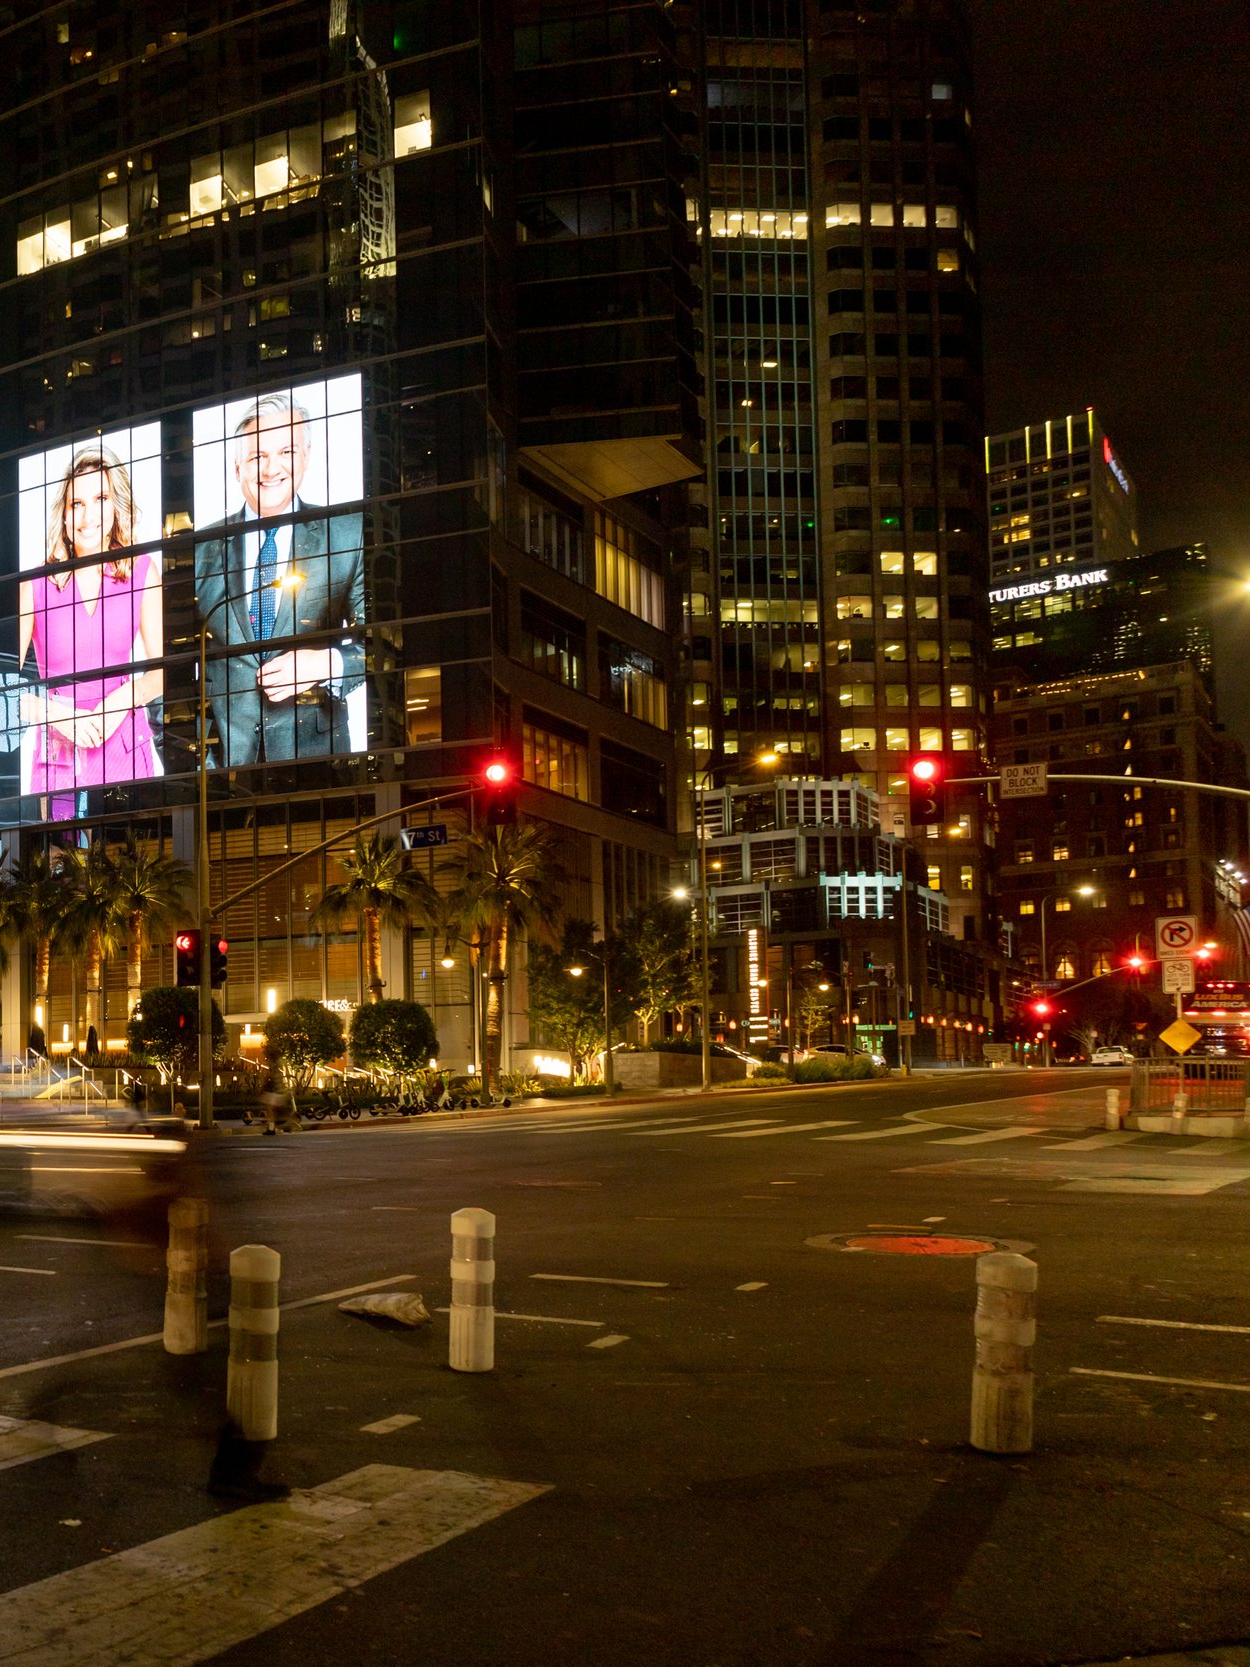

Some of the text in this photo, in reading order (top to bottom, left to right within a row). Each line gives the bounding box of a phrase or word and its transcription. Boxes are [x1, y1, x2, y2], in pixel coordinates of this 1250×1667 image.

[1054, 569, 1109, 591] BANK
[1006, 765, 1041, 778] DO NOT
[1008, 777, 1038, 788] BLOCK
[427, 830, 441, 842] St
[1190, 1000, 1248, 1008] AMERICA
